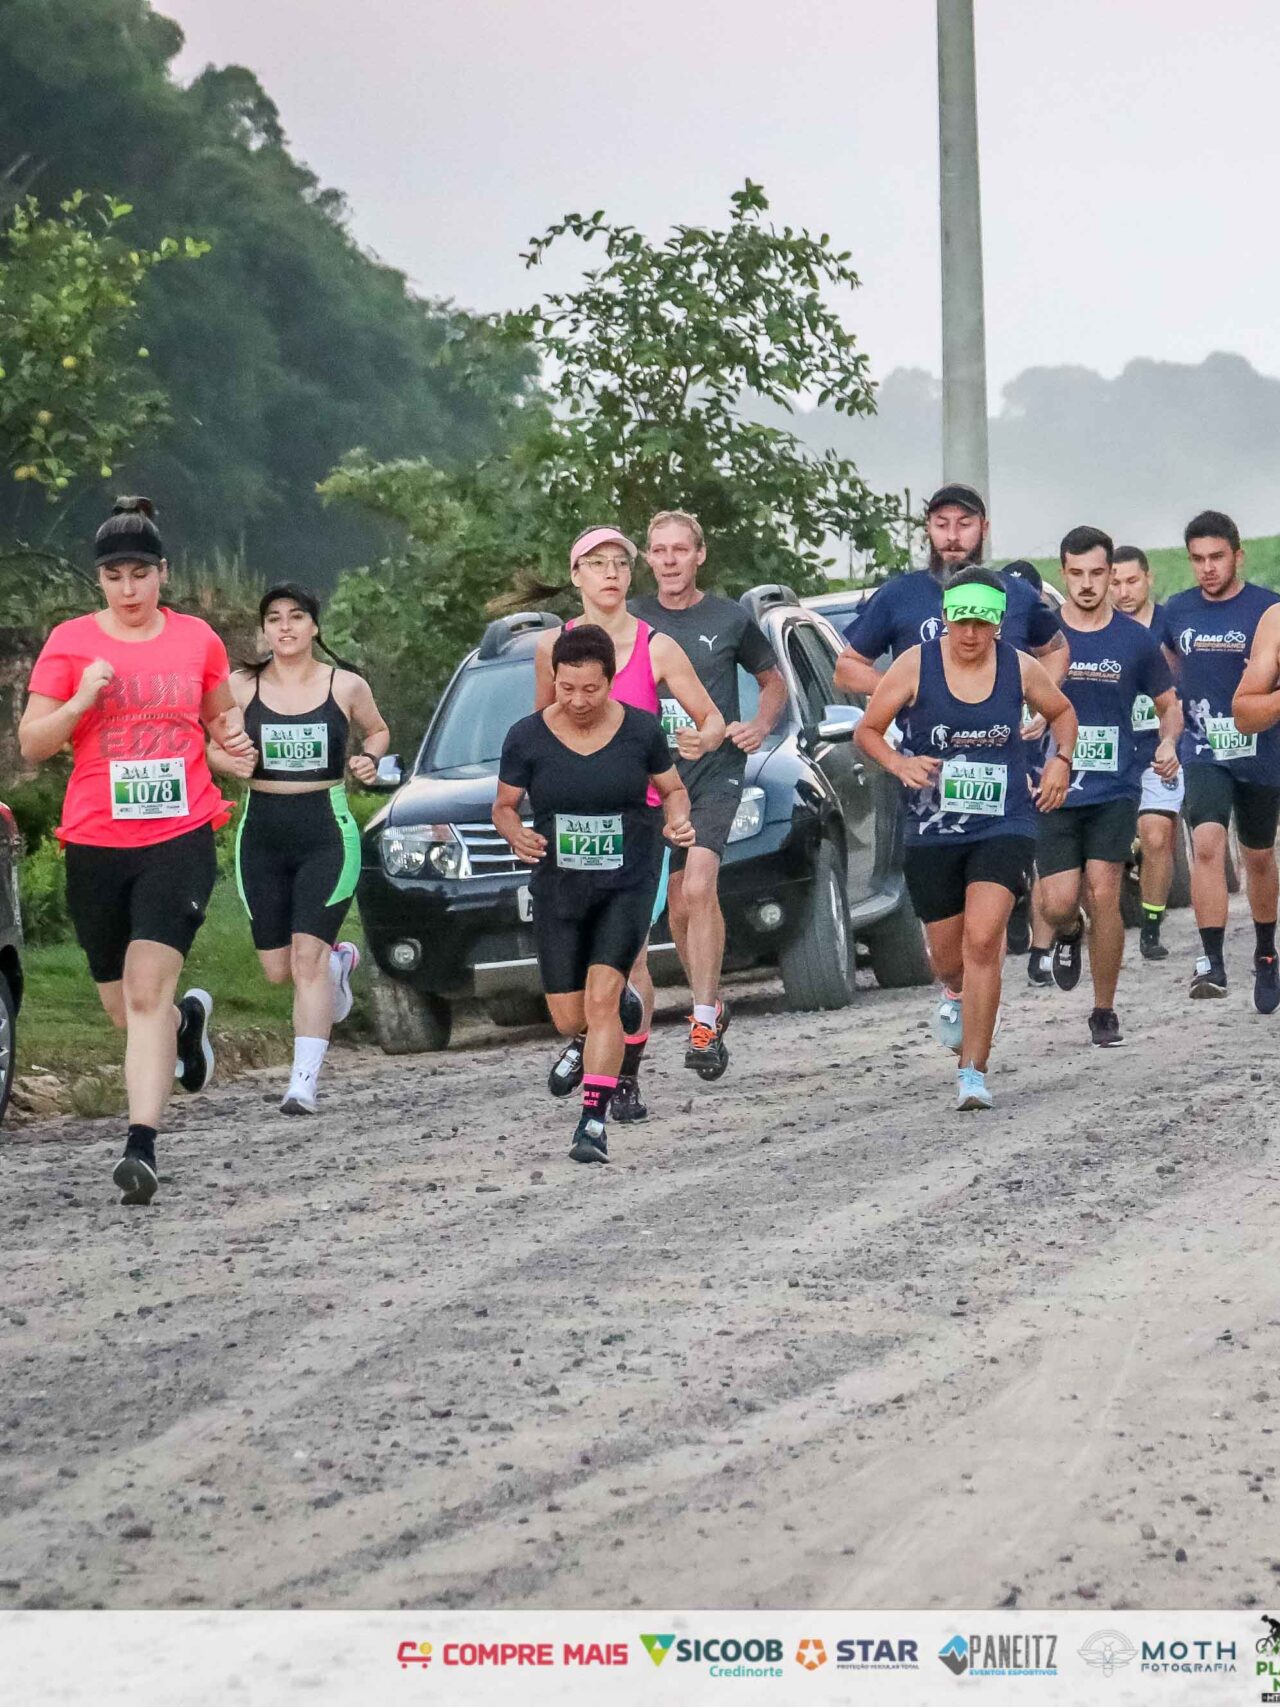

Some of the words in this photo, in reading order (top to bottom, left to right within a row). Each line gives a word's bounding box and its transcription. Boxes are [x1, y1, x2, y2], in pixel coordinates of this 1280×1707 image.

[1195, 634, 1224, 642] ADAG
[1069, 662, 1099, 671] ADAG
[1214, 732, 1247, 749] 1050
[273, 742, 314, 759] 1068
[1072, 742, 1107, 759] 054
[124, 780, 173, 803] 1078
[953, 780, 994, 800] 1070
[568, 835, 614, 855] 1214
